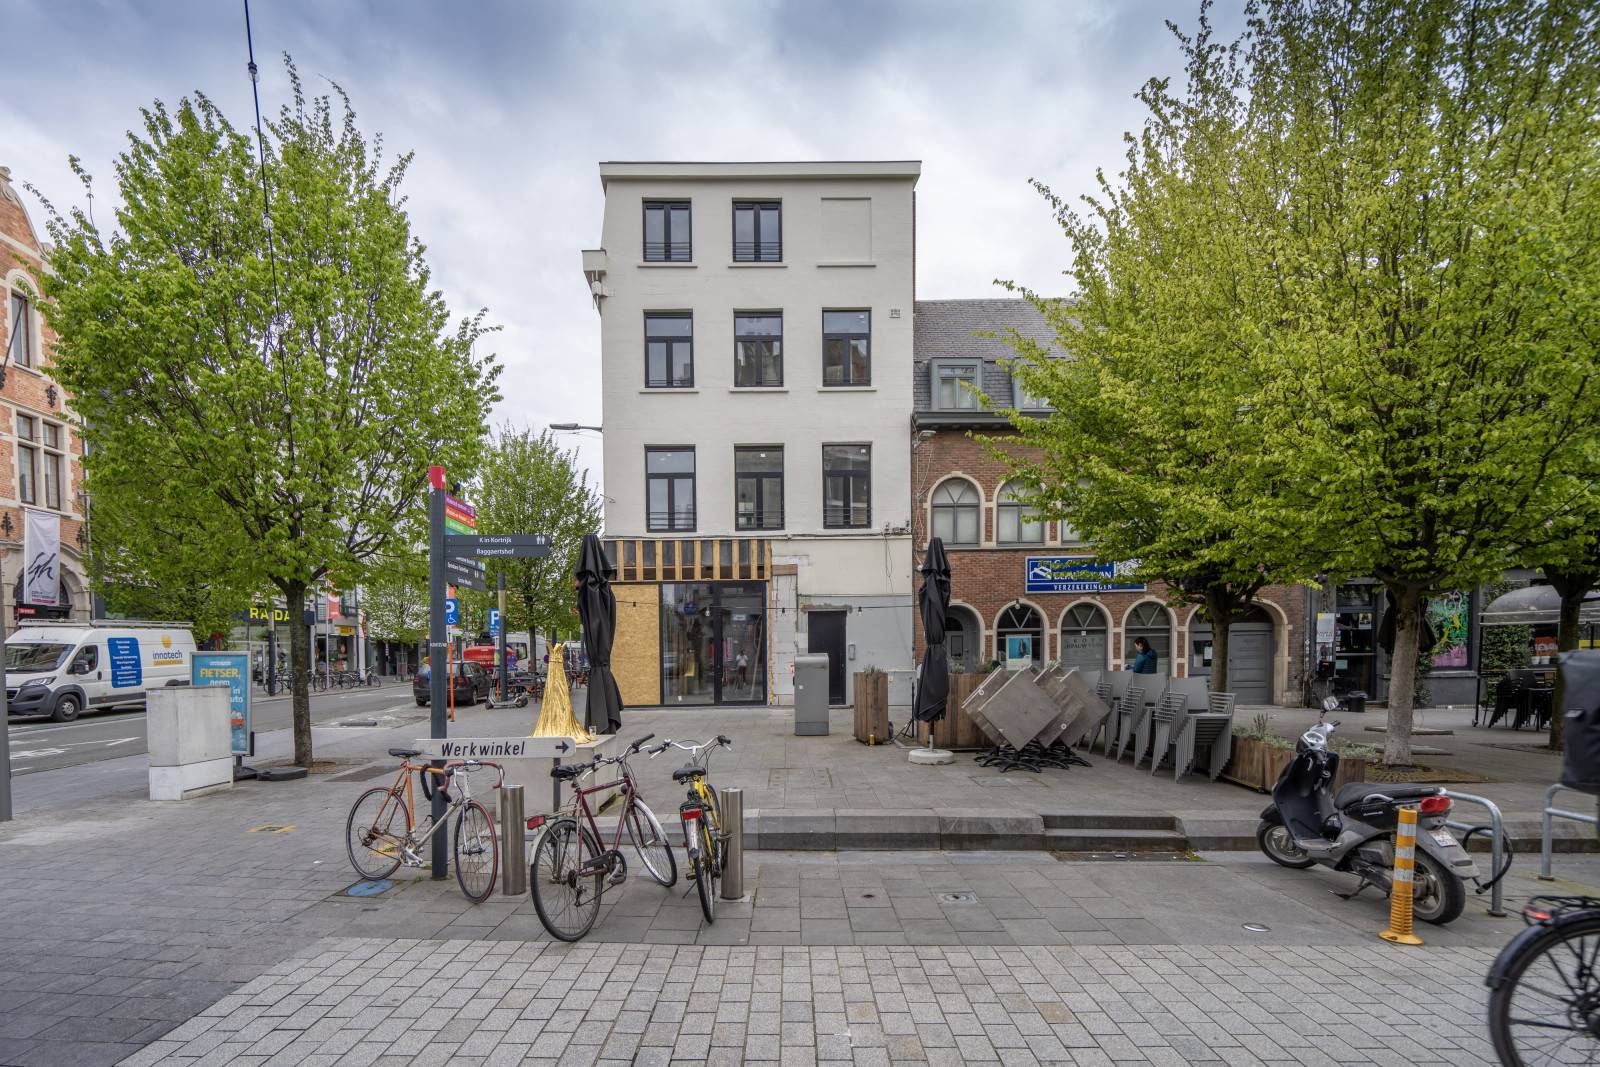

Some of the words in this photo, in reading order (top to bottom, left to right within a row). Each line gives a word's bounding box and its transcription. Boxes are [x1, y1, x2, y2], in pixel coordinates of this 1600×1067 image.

[491, 537, 512, 545] Kortrijk
[476, 548, 514, 556] Baggaertshof
[491, 610, 500, 624] P
[153, 650, 183, 660] innotech
[442, 741, 525, 757] Werkwinkel
